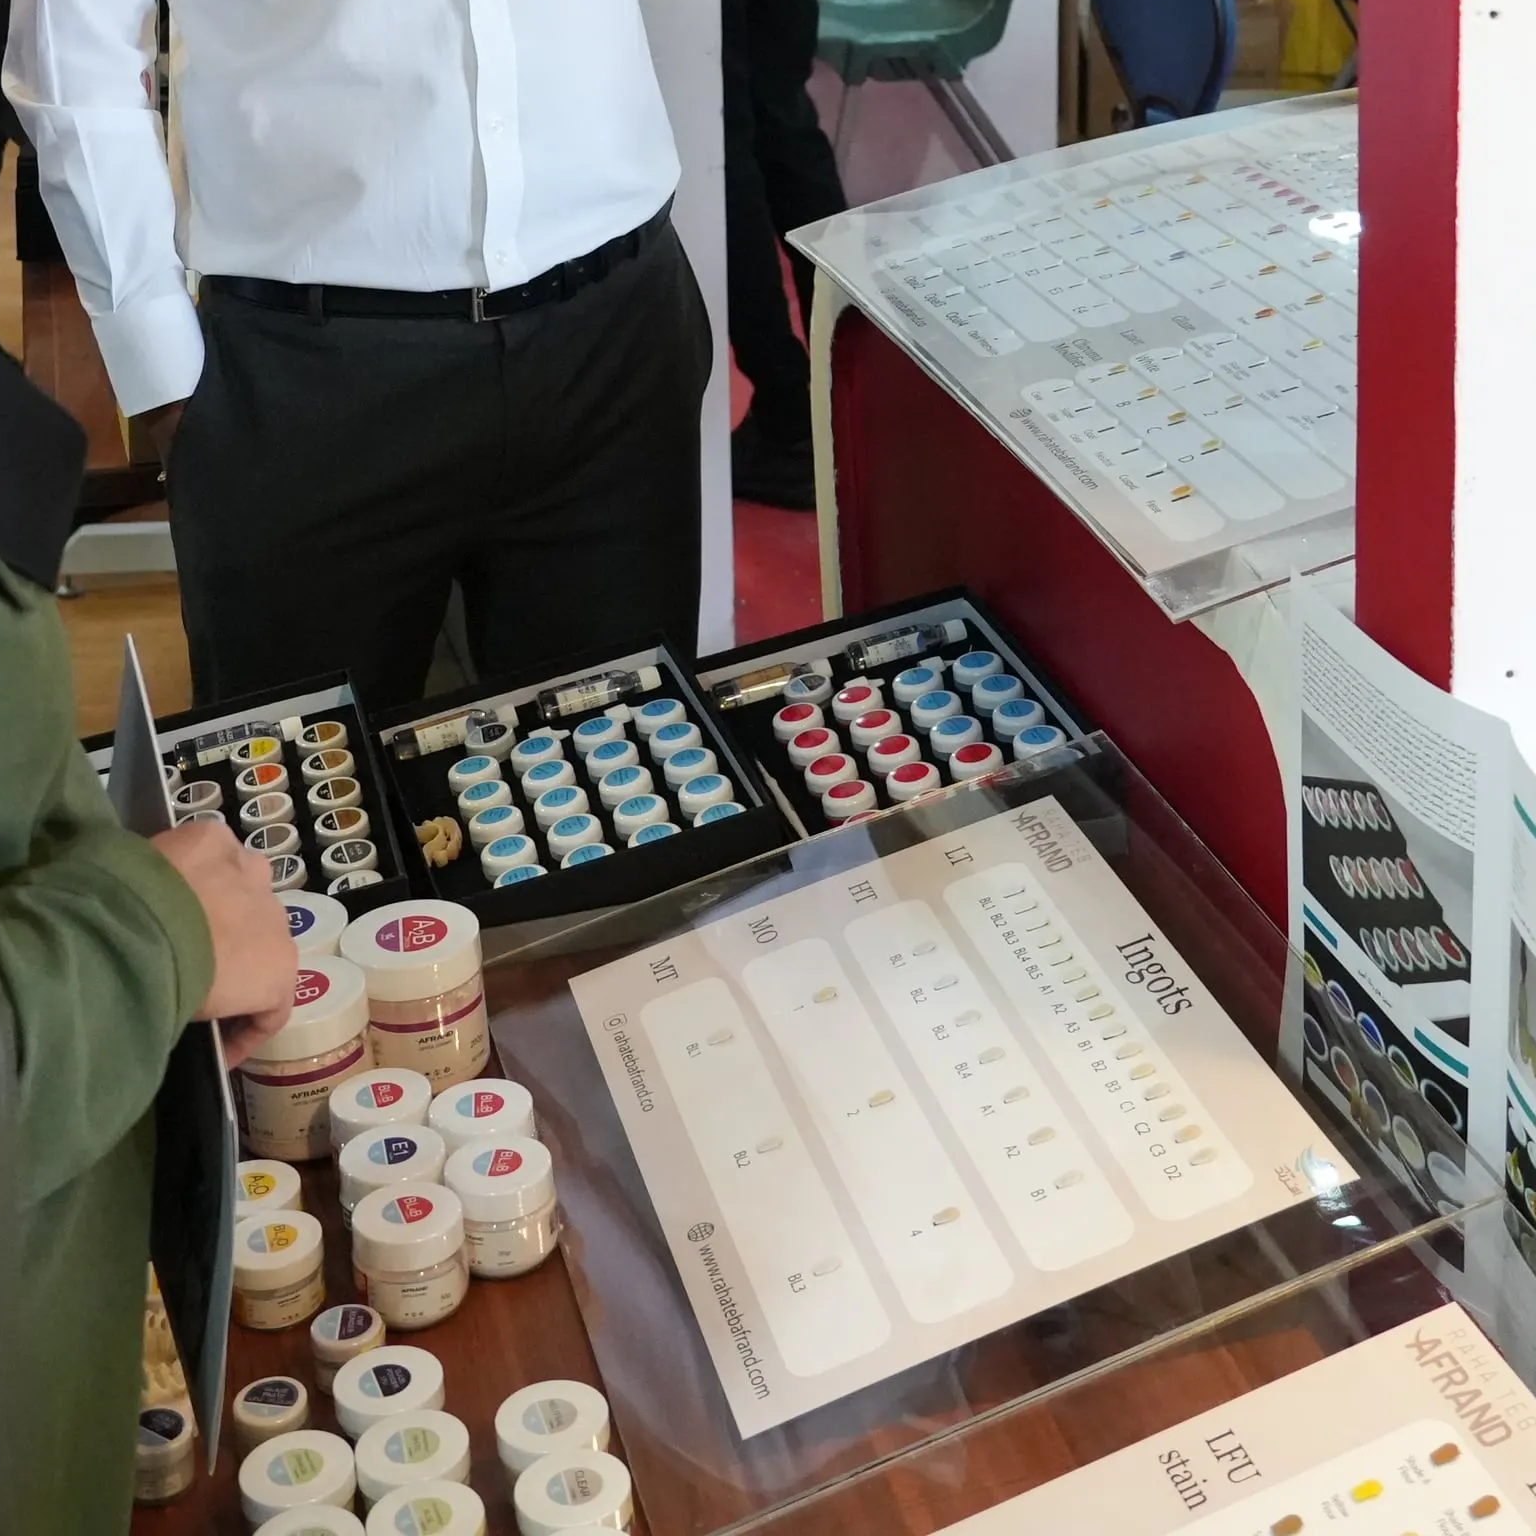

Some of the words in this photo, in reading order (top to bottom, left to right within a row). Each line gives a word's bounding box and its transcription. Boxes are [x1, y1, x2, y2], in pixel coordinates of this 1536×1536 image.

[1135, 354, 1160, 373] White
[1115, 400, 1131, 408] B
[1146, 426, 1163, 434] C
[1020, 417, 1099, 491] www.rahatebafrand.com
[1177, 454, 1195, 464] D
[1012, 809, 1073, 873] AFRAND
[944, 845, 974, 867] LT
[848, 880, 878, 904] HT
[978, 895, 997, 912] BL1
[990, 912, 1008, 929] BL2
[748, 915, 779, 945] MO
[1001, 929, 1020, 946] BL3
[889, 953, 907, 969] BL1
[1013, 947, 1032, 963] BL4
[649, 956, 679, 983] MT
[1025, 964, 1044, 980] BL5
[1115, 932, 1193, 1015] Ingots
[910, 987, 928, 1005] BL2
[1038, 983, 1055, 995] A1
[1050, 1001, 1067, 1015] A2
[931, 1024, 950, 1042] BL3
[1064, 1020, 1081, 1034] A3
[417, 1030, 454, 1044] AFRAND
[686, 1042, 702, 1058] BL1
[1077, 1039, 1094, 1052] B1
[613, 1029, 655, 1114] rahatebafrand.co
[954, 1061, 973, 1079] BL4
[1091, 1059, 1109, 1072] B2
[290, 1086, 329, 1100] AFRAND
[1104, 1079, 1122, 1094] B3
[846, 1109, 860, 1117] 2
[979, 1104, 996, 1117] A1
[1119, 1100, 1136, 1114] C1
[1134, 1121, 1151, 1136] C2
[391, 1141, 409, 1156] E1
[1004, 1144, 1021, 1159] A2
[1149, 1143, 1166, 1158] C3
[733, 1150, 751, 1168] BL2
[1163, 1164, 1182, 1181] D2
[1030, 1188, 1048, 1202] B1
[910, 1229, 923, 1238] 4
[787, 1272, 806, 1294] BL3
[698, 1243, 771, 1400] www.rahatebafrand.com
[1447, 1327, 1499, 1384] RAHA
[1405, 1327, 1512, 1447] AFRAND
[1204, 1428, 1262, 1484] LFU
[574, 1469, 591, 1497] CLEAR
[1158, 1448, 1208, 1511] stain
